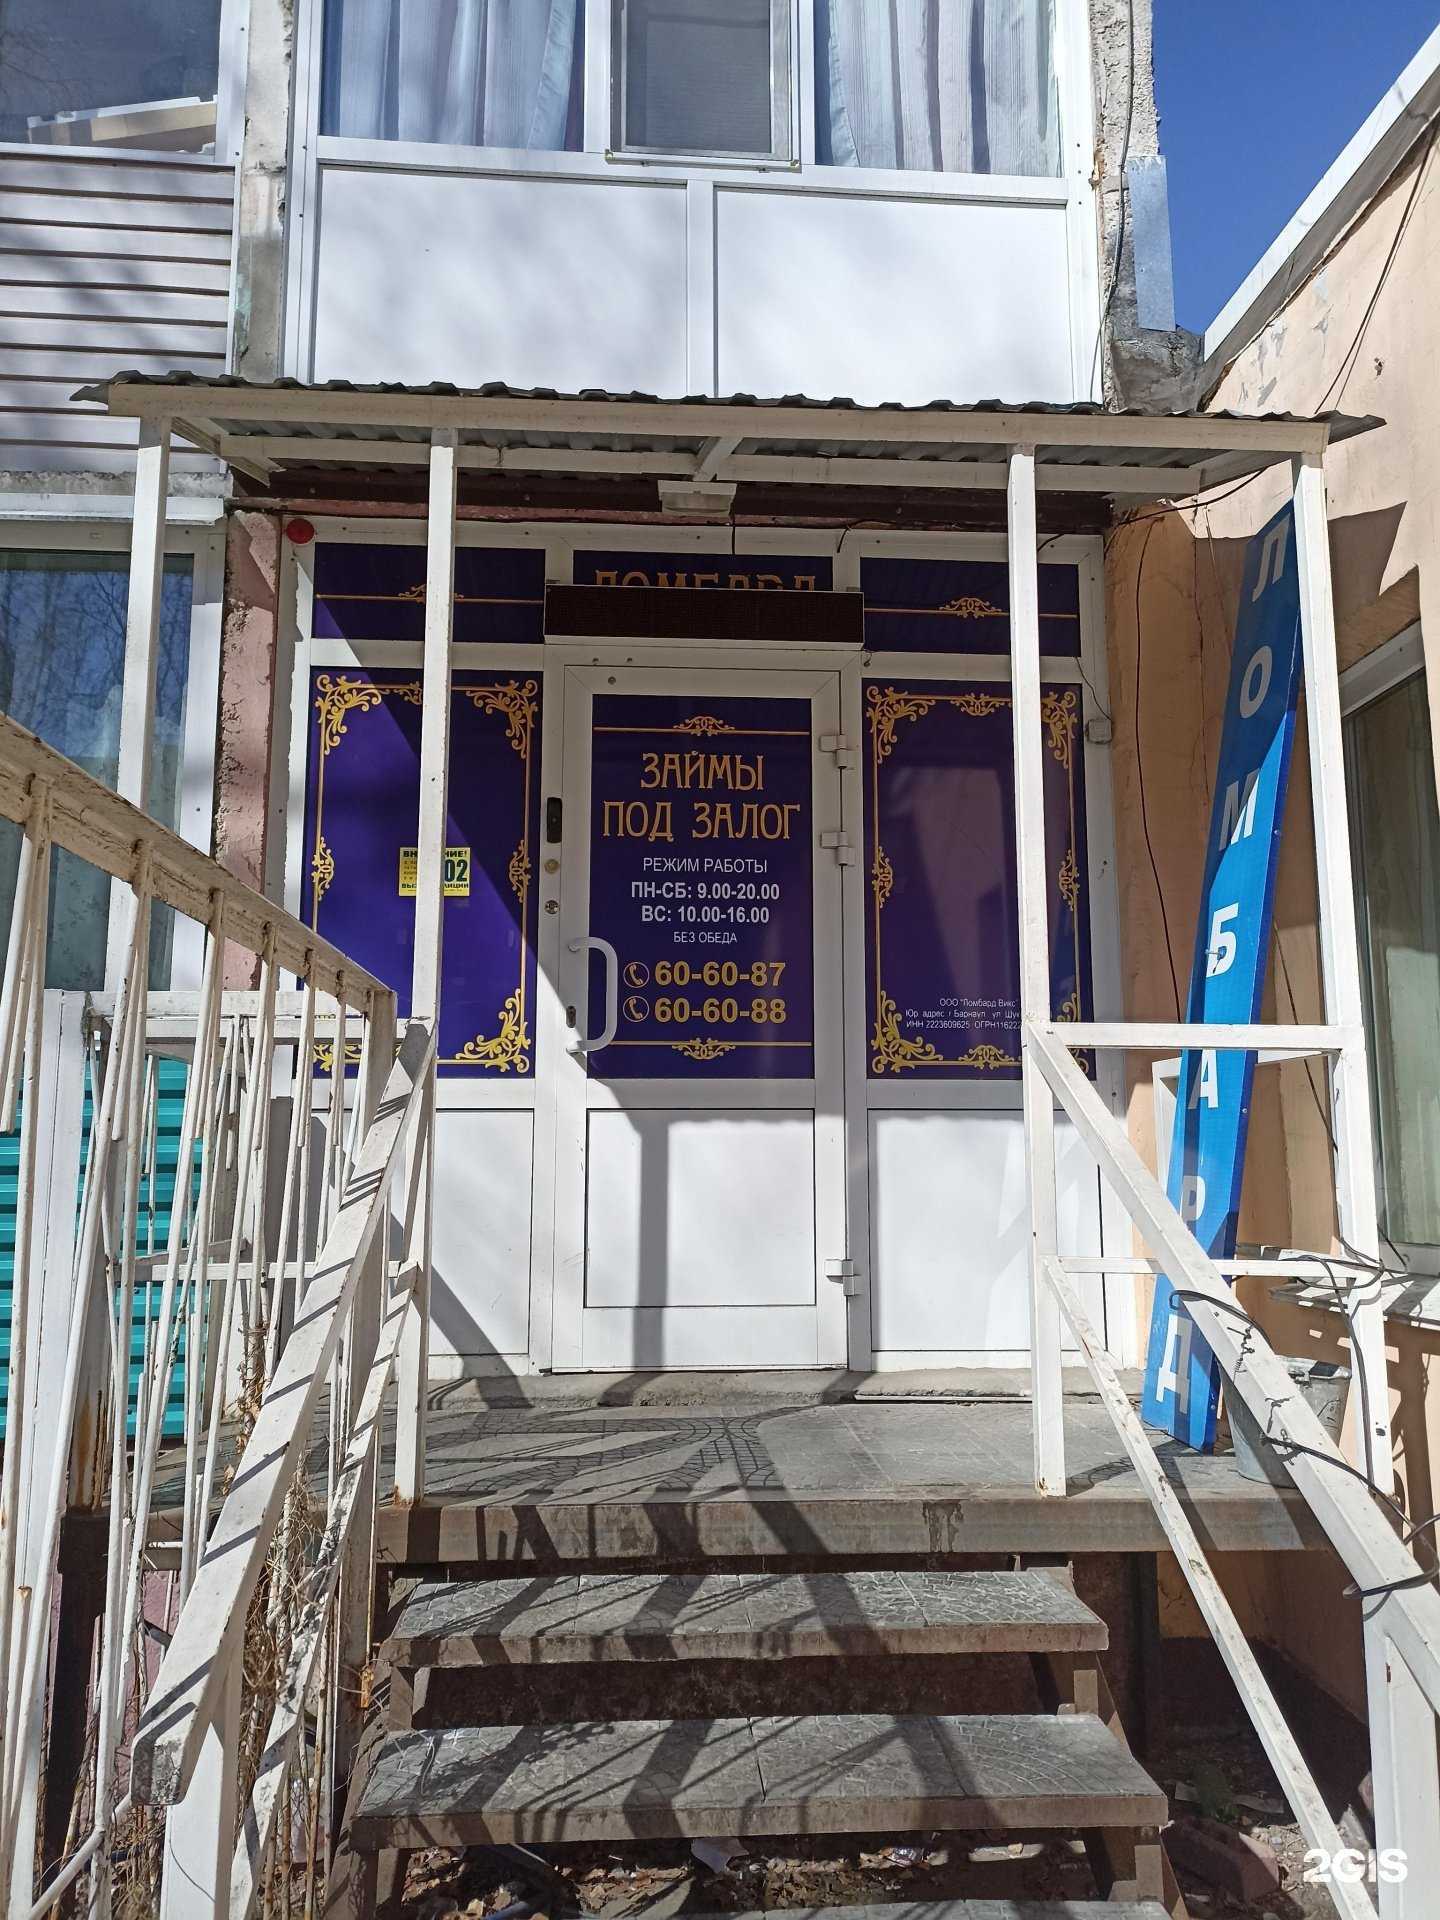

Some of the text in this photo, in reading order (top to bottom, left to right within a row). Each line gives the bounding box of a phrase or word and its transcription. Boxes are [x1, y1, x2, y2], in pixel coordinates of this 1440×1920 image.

[640, 750, 764, 790] ЗАЙМЫ
[602, 800, 801, 842] ПОД ЗАЛОГ
[643, 857, 768, 873] РЕЖИМ РАБОТЫ
[631, 881, 780, 900] ПН-СБ: 9.00-20.00
[641, 905, 770, 923] ВС: 10.00-16.00
[673, 931, 738, 944] БЕЗ ОБЕДА
[1156, 512, 1291, 1415] ЛОМБАРД
[654, 961, 786, 987] 60-60-87
[654, 998, 787, 1024] 60-60-88
[940, 998, 959, 1007] ООО
[906, 1020, 924, 1029] ИНН
